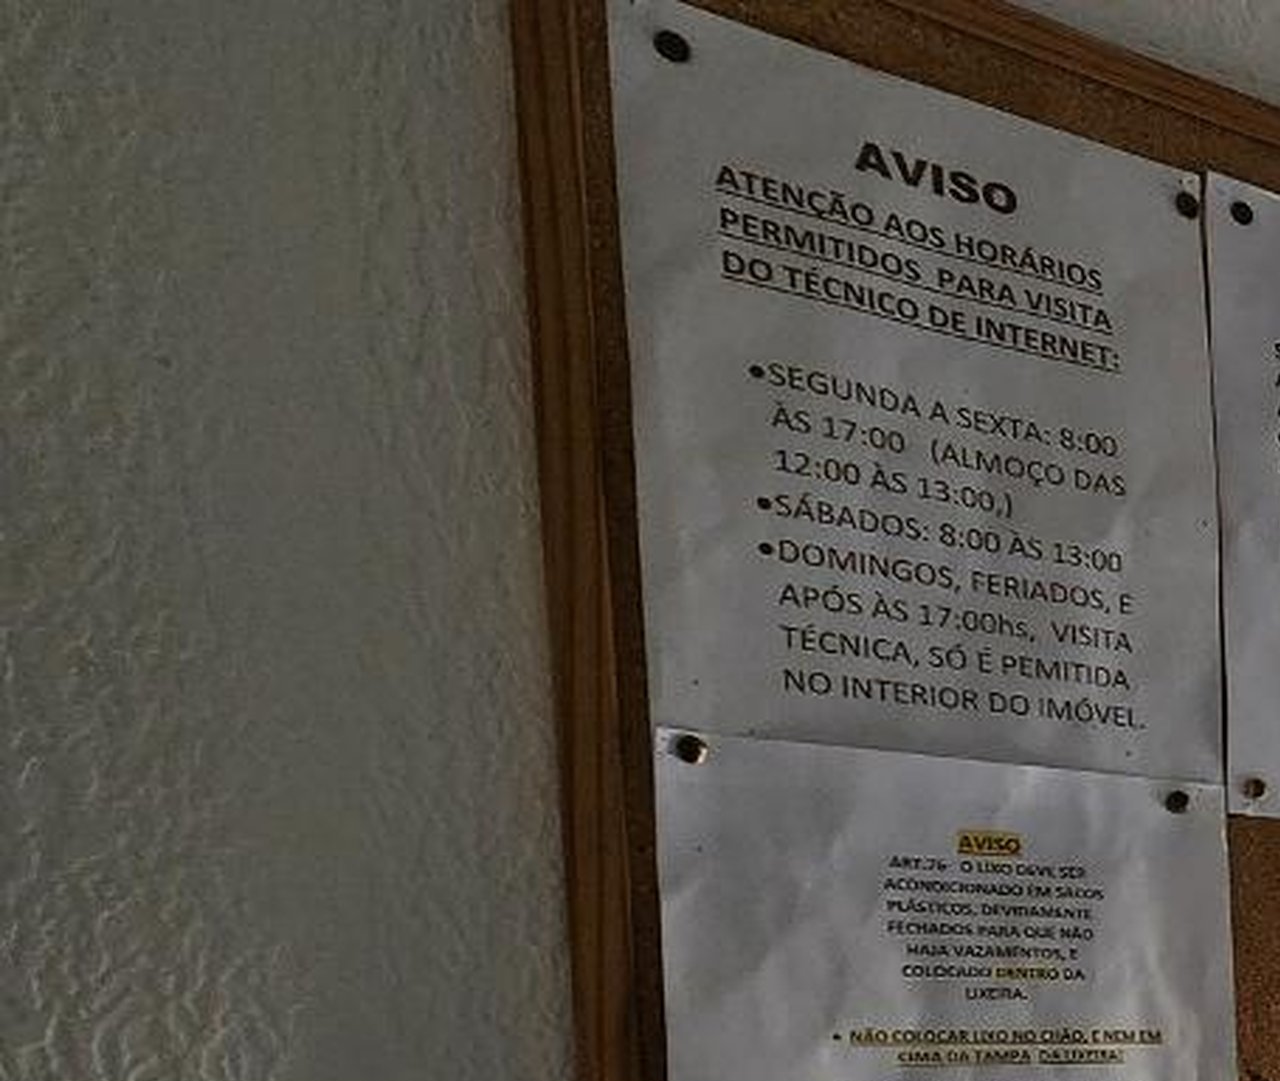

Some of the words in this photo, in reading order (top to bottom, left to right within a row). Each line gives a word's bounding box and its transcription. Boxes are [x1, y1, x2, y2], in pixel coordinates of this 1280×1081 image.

[854, 143, 1017, 214] AVISO
[715, 166, 873, 227] ATENÇÃO
[884, 214, 944, 248] AOS
[956, 234, 1102, 289] HORÁRIOS
[720, 208, 920, 281] PERMITIDOS
[937, 269, 1016, 305] PARA
[1024, 290, 1112, 329] VISITA
[723, 251, 772, 281] DO
[782, 265, 917, 320] TÉCNICO
[929, 305, 965, 332] DE
[976, 317, 1119, 368] INTERNET:
[768, 364, 920, 417] SEGUNDA
[929, 402, 948, 424] A
[956, 408, 1050, 444] SEXTA:
[1059, 428, 1116, 456] 8:00
[772, 407, 810, 433] ÀS
[823, 419, 904, 453] 17:00
[930, 440, 1064, 485] (ALMOÇO
[1074, 469, 1126, 496] DAS
[774, 451, 859, 485] 12:00
[870, 464, 907, 493] ÀS
[774, 493, 928, 541] SÁBADOS:
[938, 523, 1000, 553] 8:00
[1008, 530, 1042, 560] ÀS
[1054, 543, 1122, 572] 13:00
[778, 540, 960, 593] DOMINGOS,
[972, 571, 1110, 613] FERIADOS,
[1119, 594, 1134, 614] E
[778, 584, 862, 614] APÓS
[872, 592, 908, 622] ÀS
[918, 605, 1034, 642] 17:00hs,
[1051, 621, 1132, 653] VISITA
[780, 624, 919, 667] TÉCNICA,
[928, 644, 967, 670] SÓ
[1002, 655, 1129, 690] PEMITIDA
[784, 669, 831, 695] NO
[842, 676, 978, 710] INTERIOR
[988, 692, 1030, 715] DO
[1040, 698, 1145, 728] IMÓVEL.
